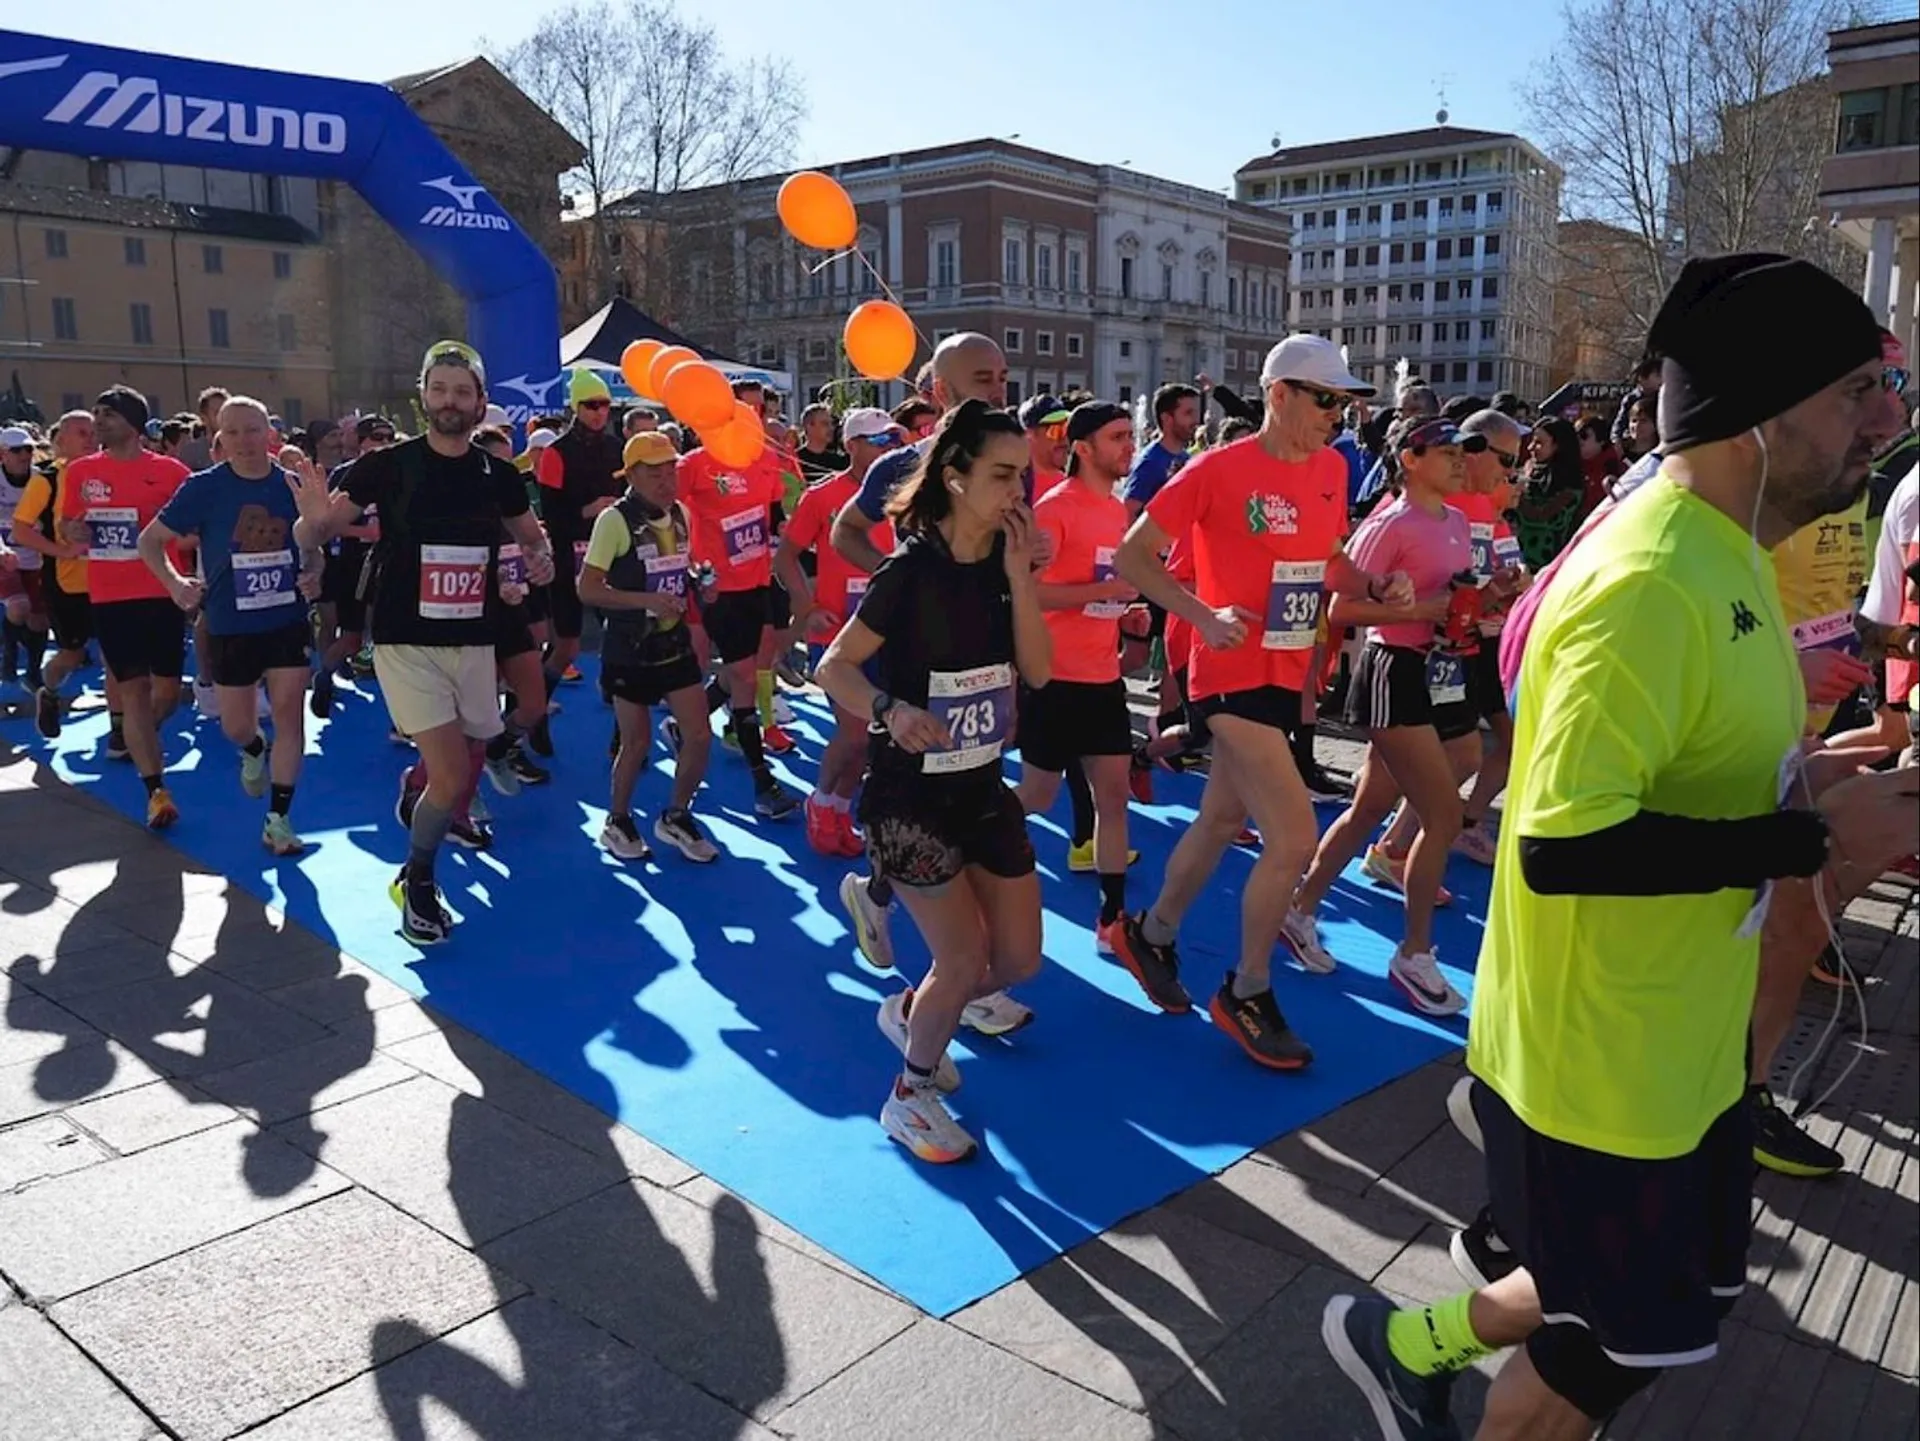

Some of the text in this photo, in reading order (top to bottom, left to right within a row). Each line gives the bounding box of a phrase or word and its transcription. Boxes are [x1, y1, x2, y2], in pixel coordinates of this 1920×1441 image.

[43, 71, 347, 153] MIZUNO
[420, 206, 511, 231] MIZUNO
[96, 526, 131, 544] 352
[246, 570, 282, 592] 209
[429, 571, 483, 596] 1092
[1282, 592, 1319, 622] 339
[947, 700, 995, 738] 783
